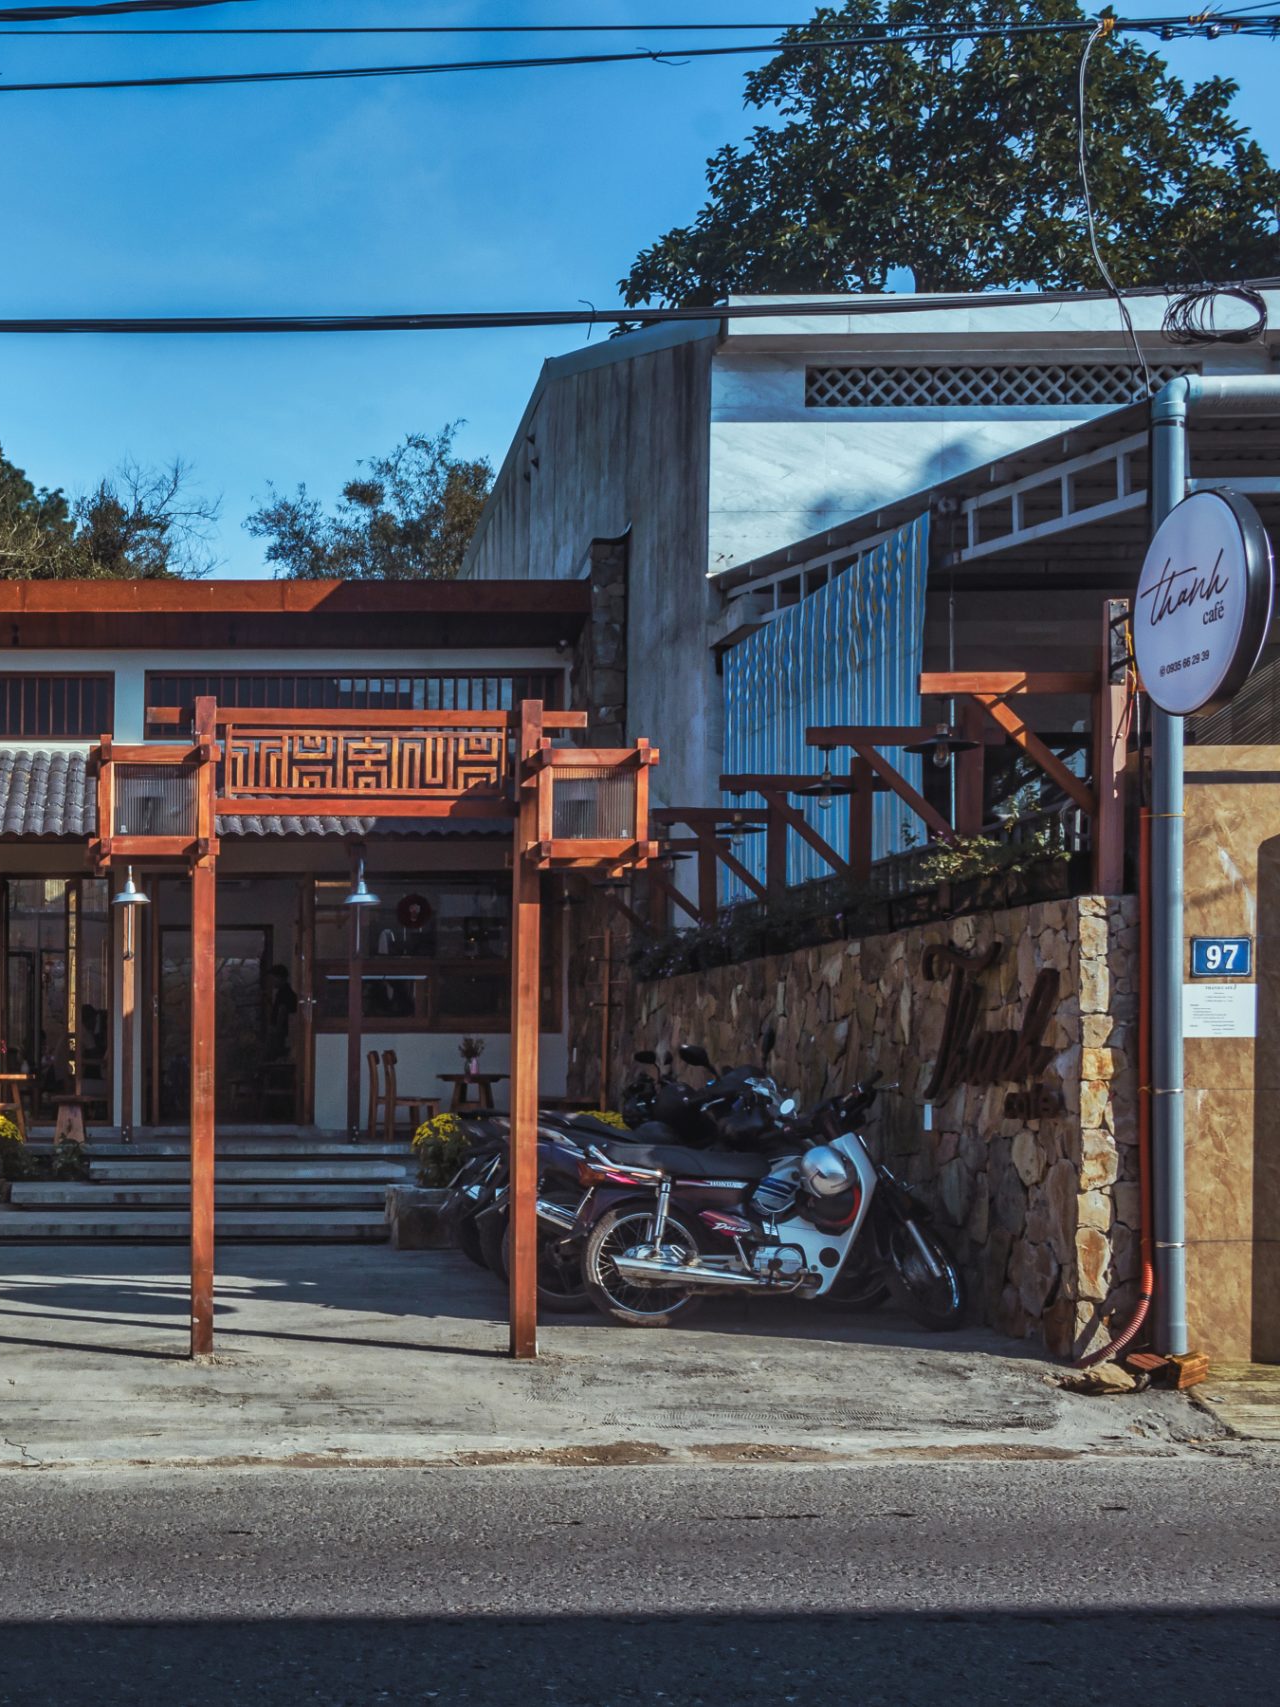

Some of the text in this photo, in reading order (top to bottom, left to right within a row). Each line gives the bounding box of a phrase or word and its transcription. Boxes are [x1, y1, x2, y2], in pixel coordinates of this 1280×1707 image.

[1140, 548, 1229, 626] thanh
[1202, 600, 1225, 625] café
[1166, 649, 1210, 675] 0935 66 29 39
[1206, 944, 1239, 970] 97
